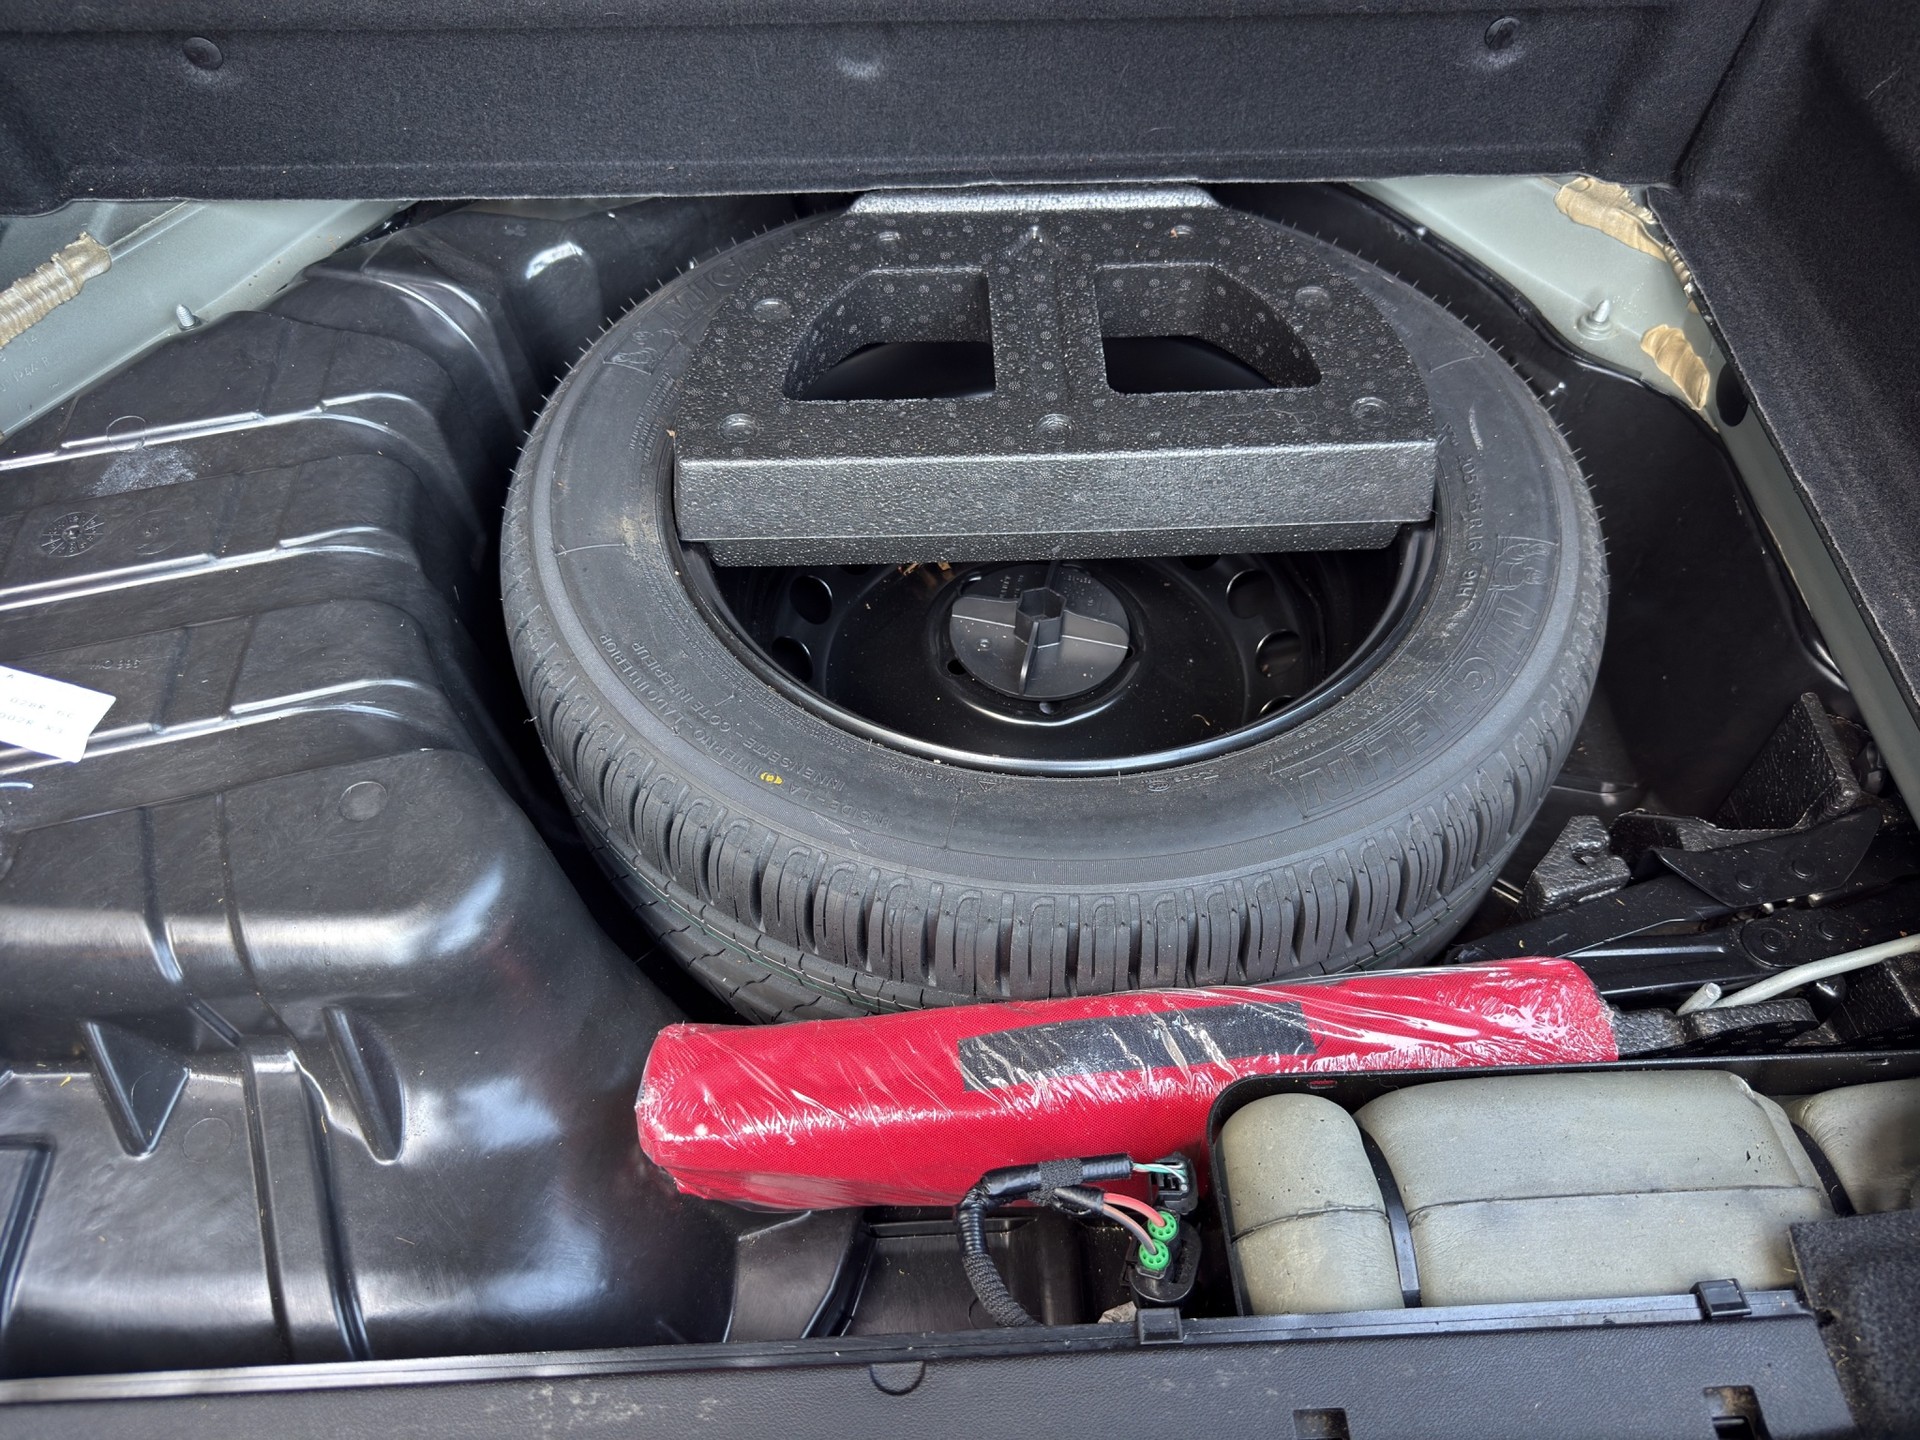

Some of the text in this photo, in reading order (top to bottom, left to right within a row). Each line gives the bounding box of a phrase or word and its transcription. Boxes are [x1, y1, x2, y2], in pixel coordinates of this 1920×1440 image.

[599, 631, 651, 692] INTERIOR
[631, 640, 695, 704] INTERIEUR
[647, 689, 684, 725] LADO
[1298, 592, 1539, 812] MICHELIN
[693, 729, 761, 778] INTERNO
[742, 736, 847, 792] INNENSEITE
